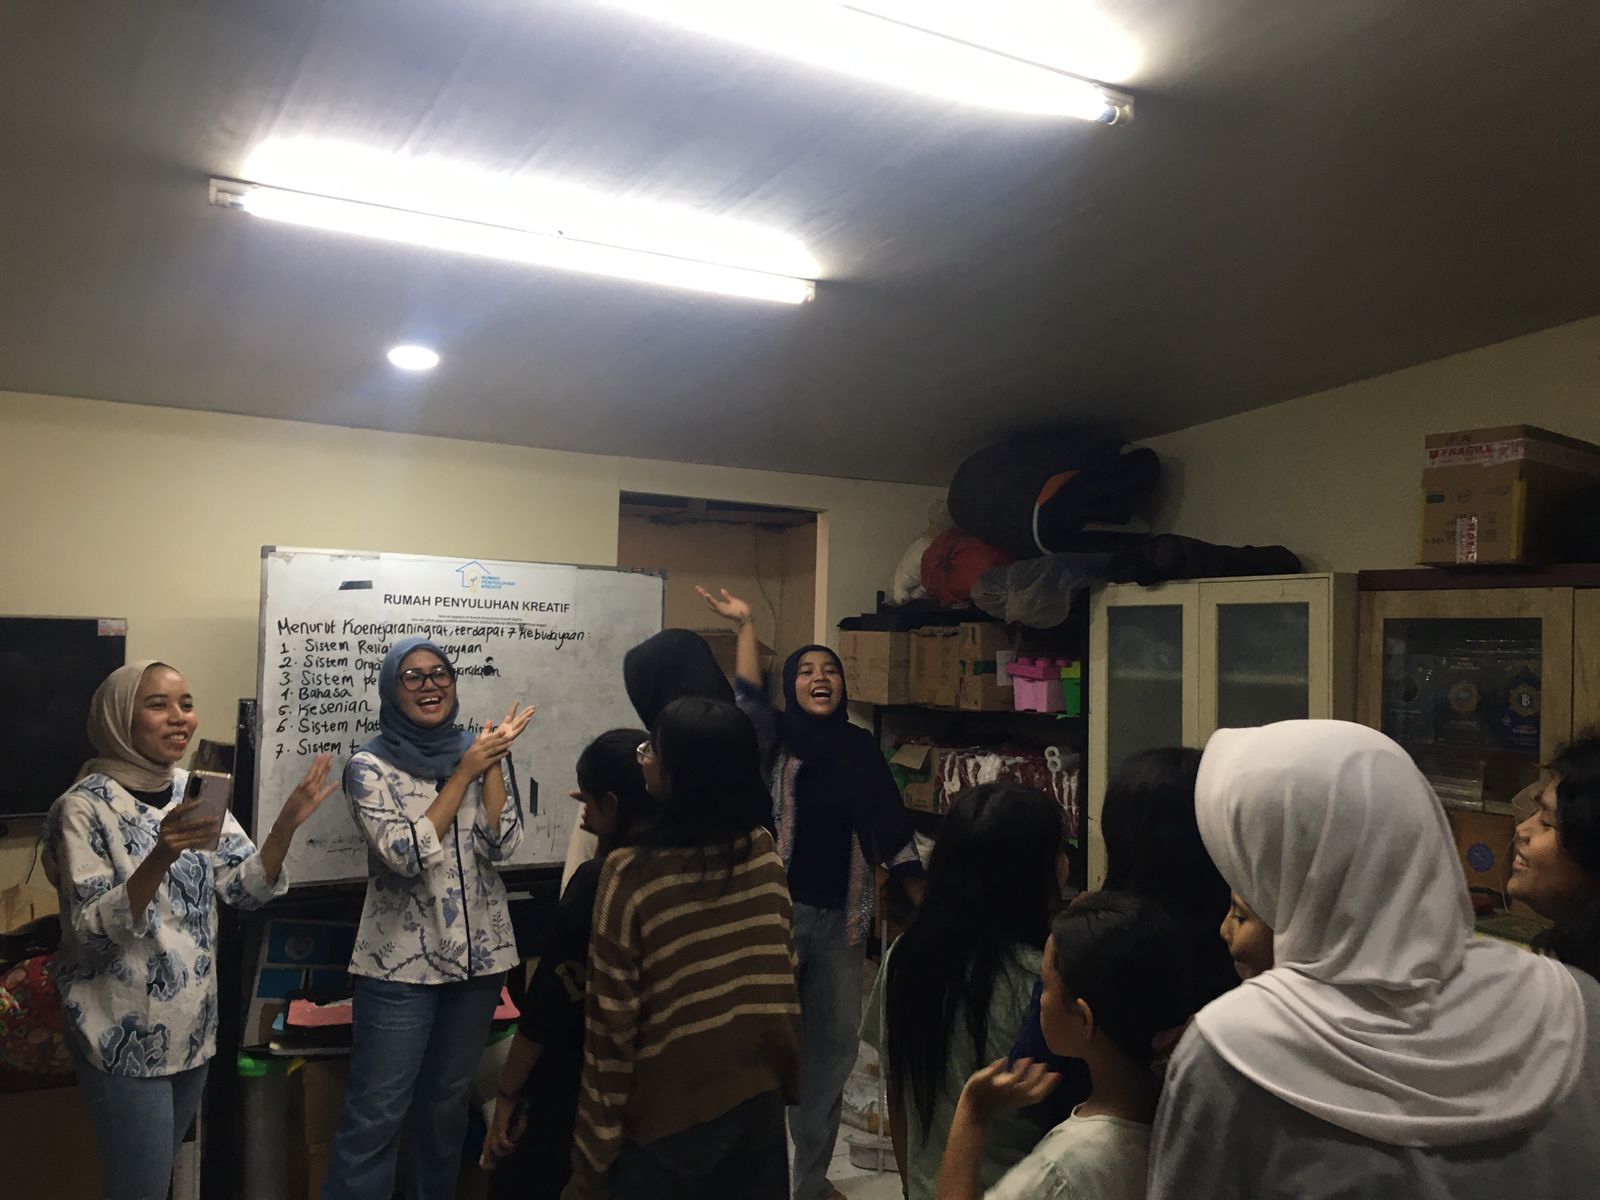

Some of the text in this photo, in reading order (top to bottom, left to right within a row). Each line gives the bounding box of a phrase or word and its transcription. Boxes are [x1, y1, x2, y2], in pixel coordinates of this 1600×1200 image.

[384, 594, 570, 614] RUMAH PENYULUHAN KREATIF
[277, 617, 336, 636] Menurut
[508, 628, 517, 639] 7
[305, 639, 349, 652] Sistem
[303, 654, 349, 668] Sistem
[301, 670, 355, 688] Sistem
[298, 687, 352, 700] Bahasa
[297, 700, 373, 717] Kesenian
[298, 718, 349, 736] Sistem
[296, 738, 342, 756] Sistem
